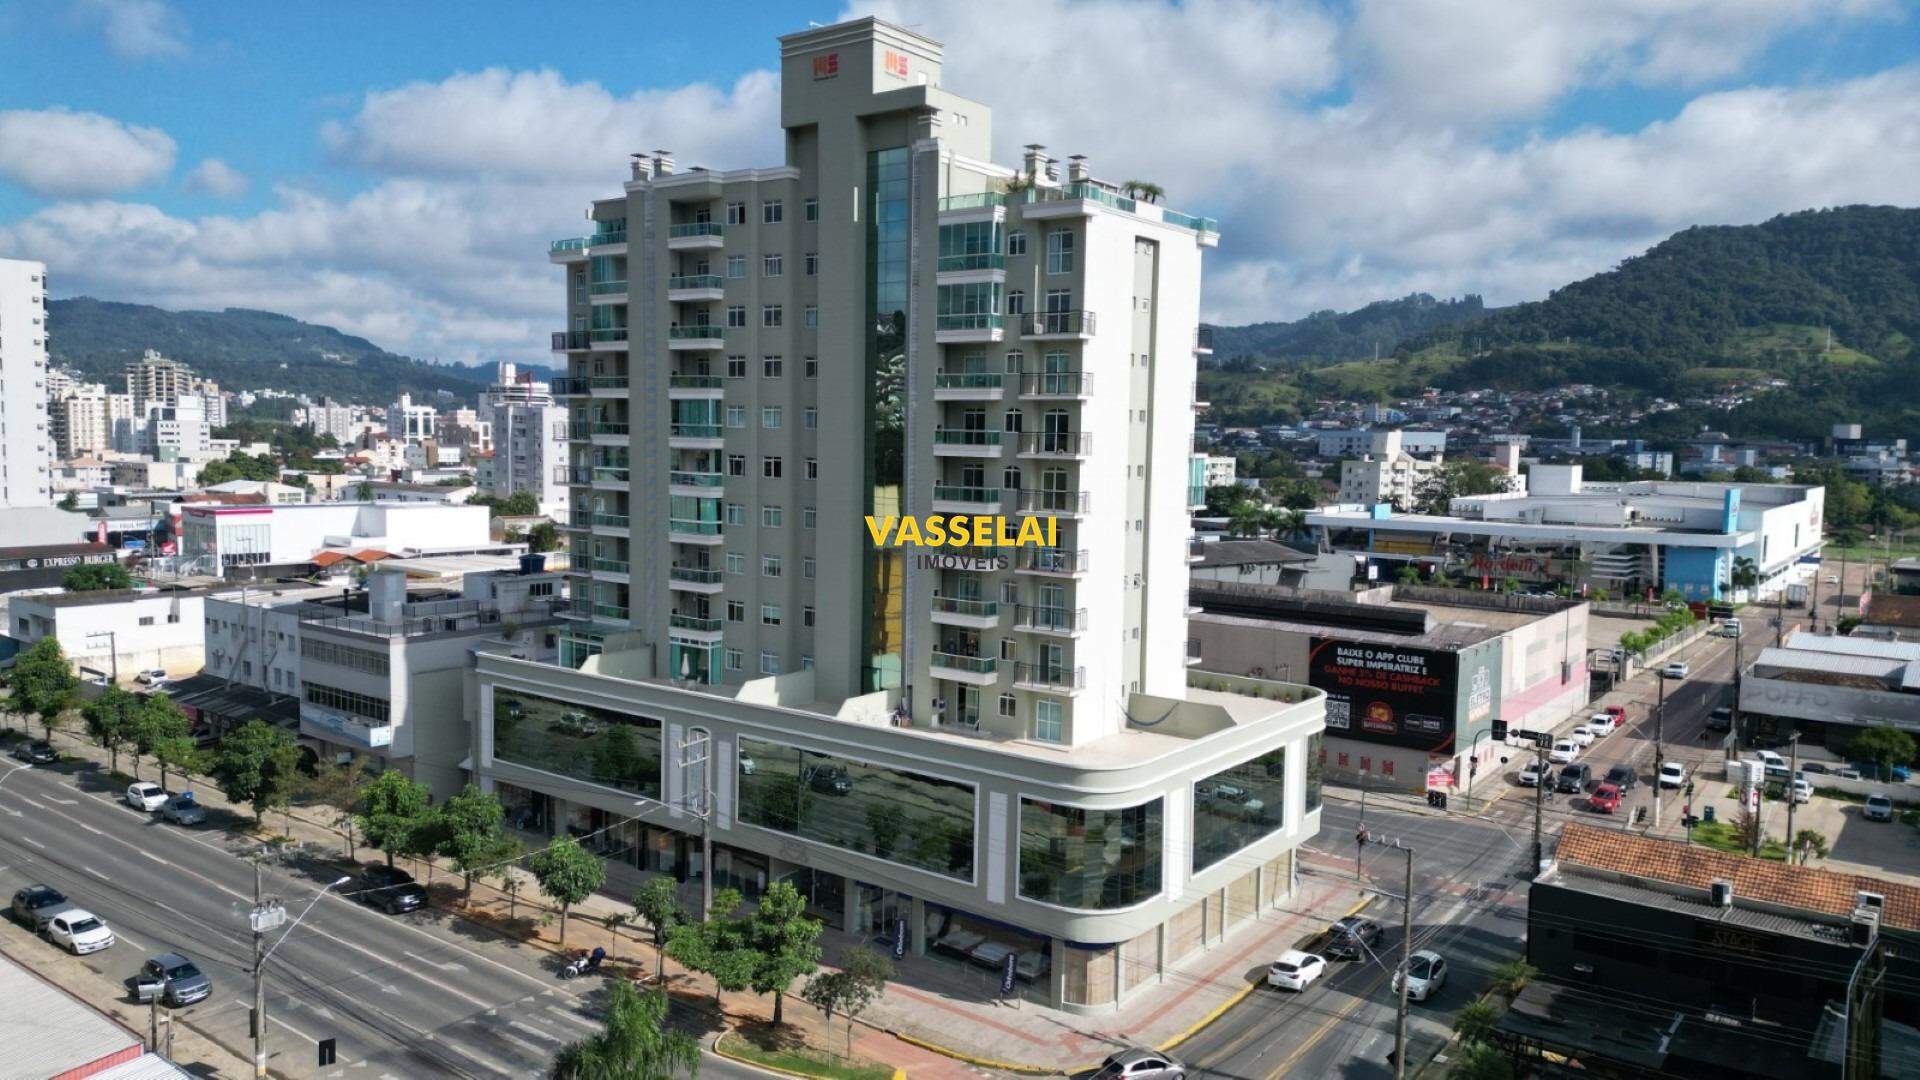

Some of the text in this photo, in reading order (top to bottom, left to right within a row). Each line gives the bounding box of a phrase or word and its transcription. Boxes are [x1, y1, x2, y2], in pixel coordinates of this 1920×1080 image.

[1337, 647, 1425, 665] BAIXE O APP CLUBE
[1336, 657, 1364, 668] SUPER
[1367, 660, 1420, 674] IMPERATRIZ
